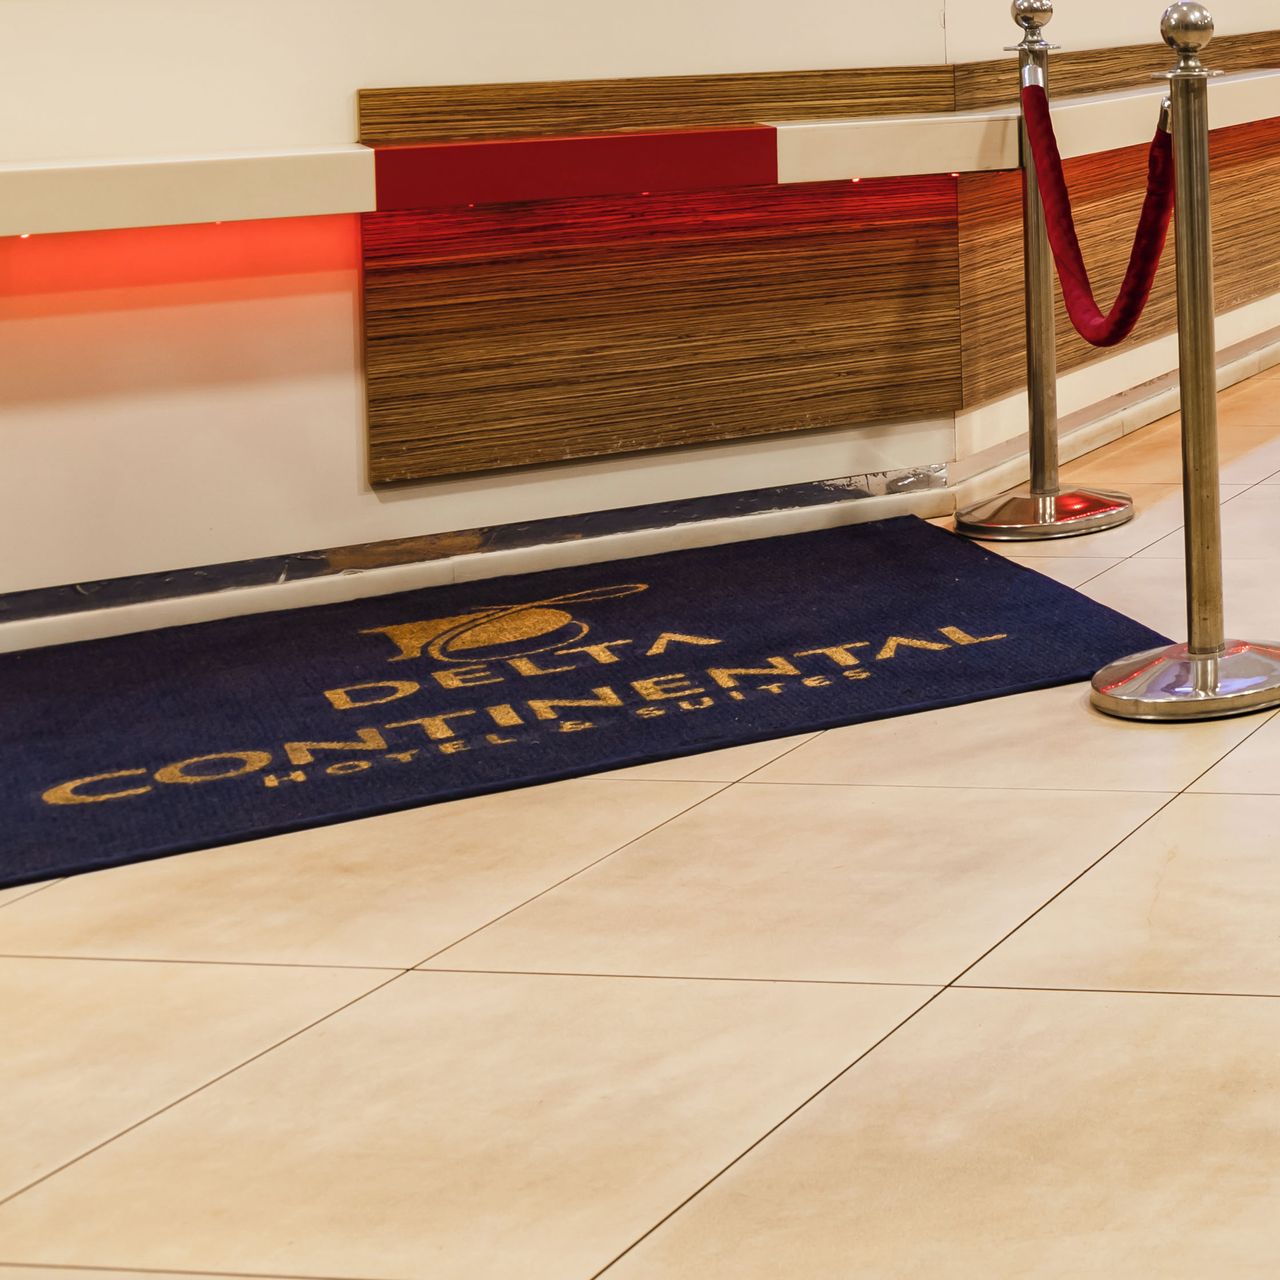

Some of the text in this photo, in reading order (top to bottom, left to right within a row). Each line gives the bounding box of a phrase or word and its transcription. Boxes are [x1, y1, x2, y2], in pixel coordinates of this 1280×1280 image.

[41, 625, 1008, 806] CONTINENTAL
[262, 733, 518, 788] HOTEL
[636, 668, 872, 719] SUITES
[323, 631, 723, 710] DELTA
